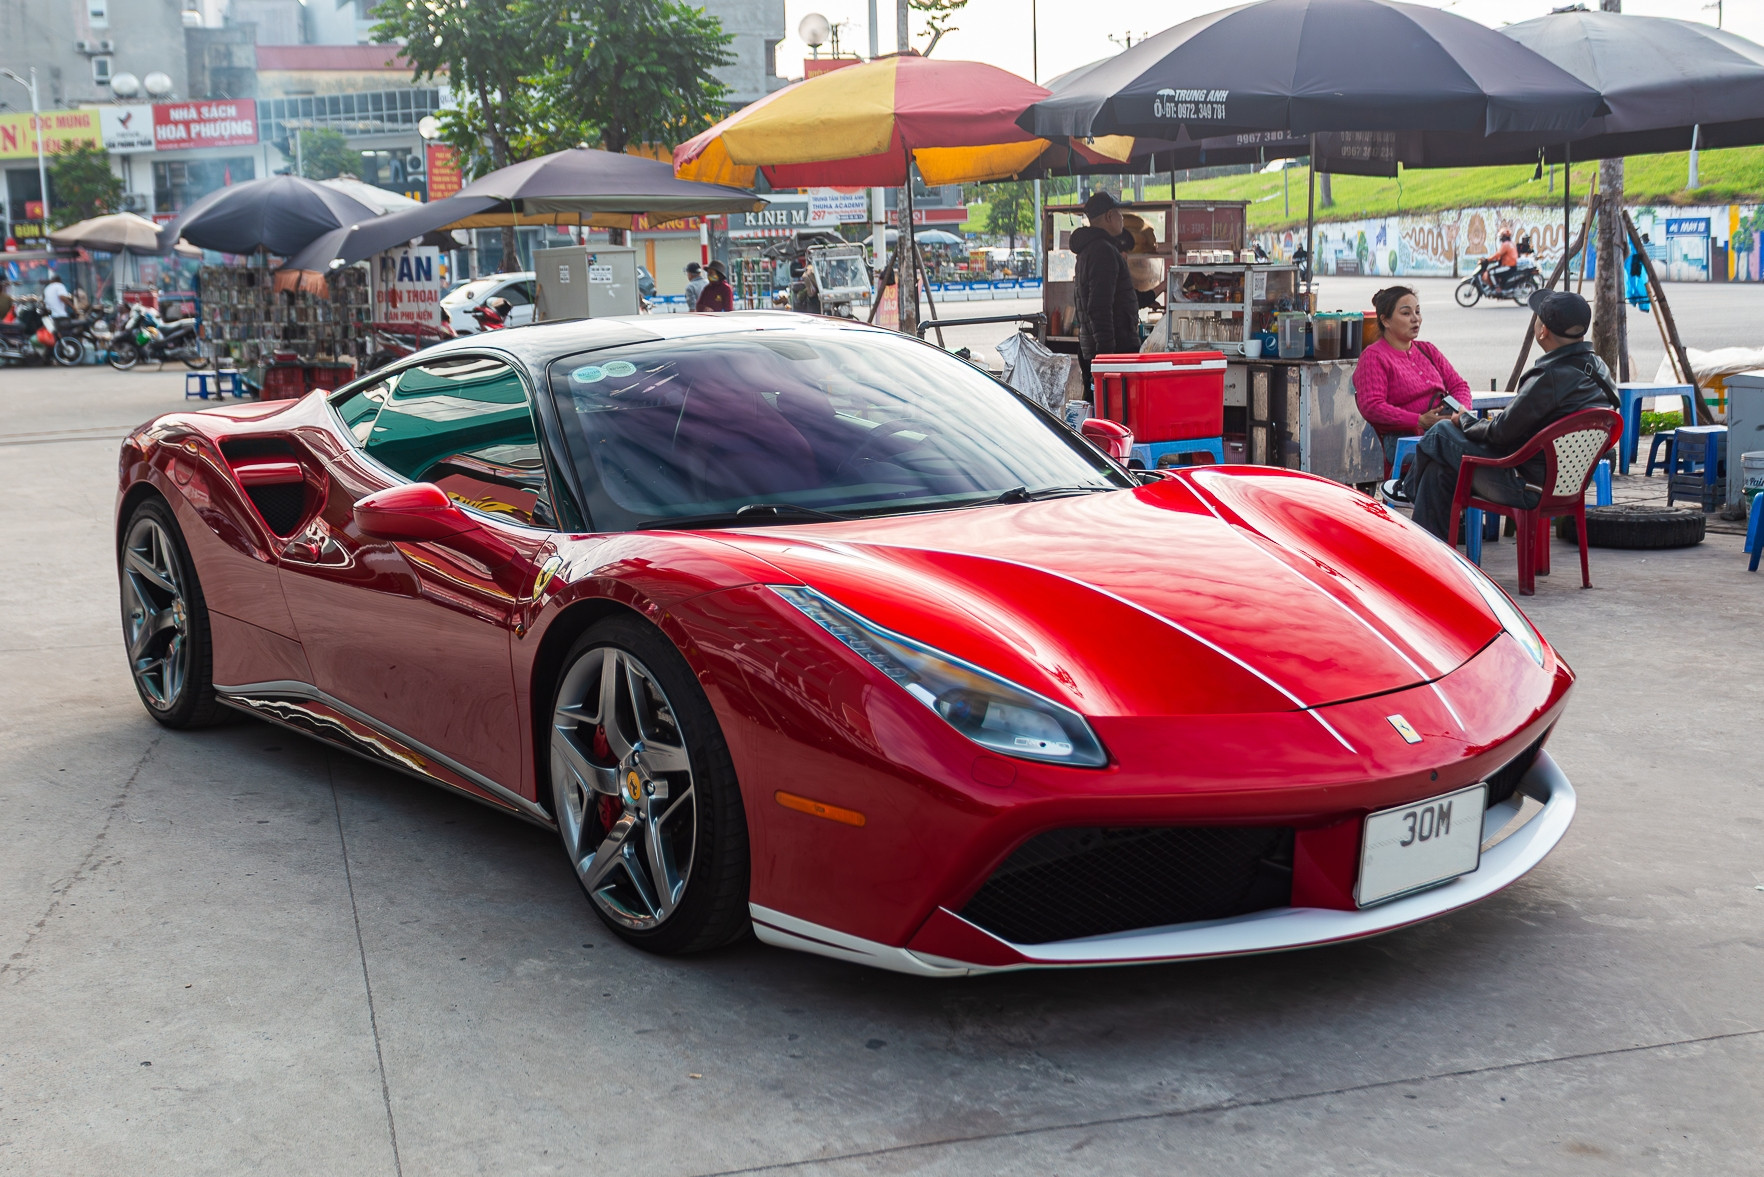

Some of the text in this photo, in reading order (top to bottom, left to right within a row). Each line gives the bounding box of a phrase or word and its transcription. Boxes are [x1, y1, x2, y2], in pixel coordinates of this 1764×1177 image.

[1174, 89, 1229, 102] TRUNG ANH
[169, 103, 237, 121] NHÀ SÁCH
[1178, 103, 1197, 119] 0972.
[1198, 103, 1212, 119] 349
[1213, 104, 1226, 119] 781
[156, 120, 254, 140] HOA PHƯỢNG
[405, 289, 438, 306] THOẠI
[1400, 801, 1453, 847] 30M
